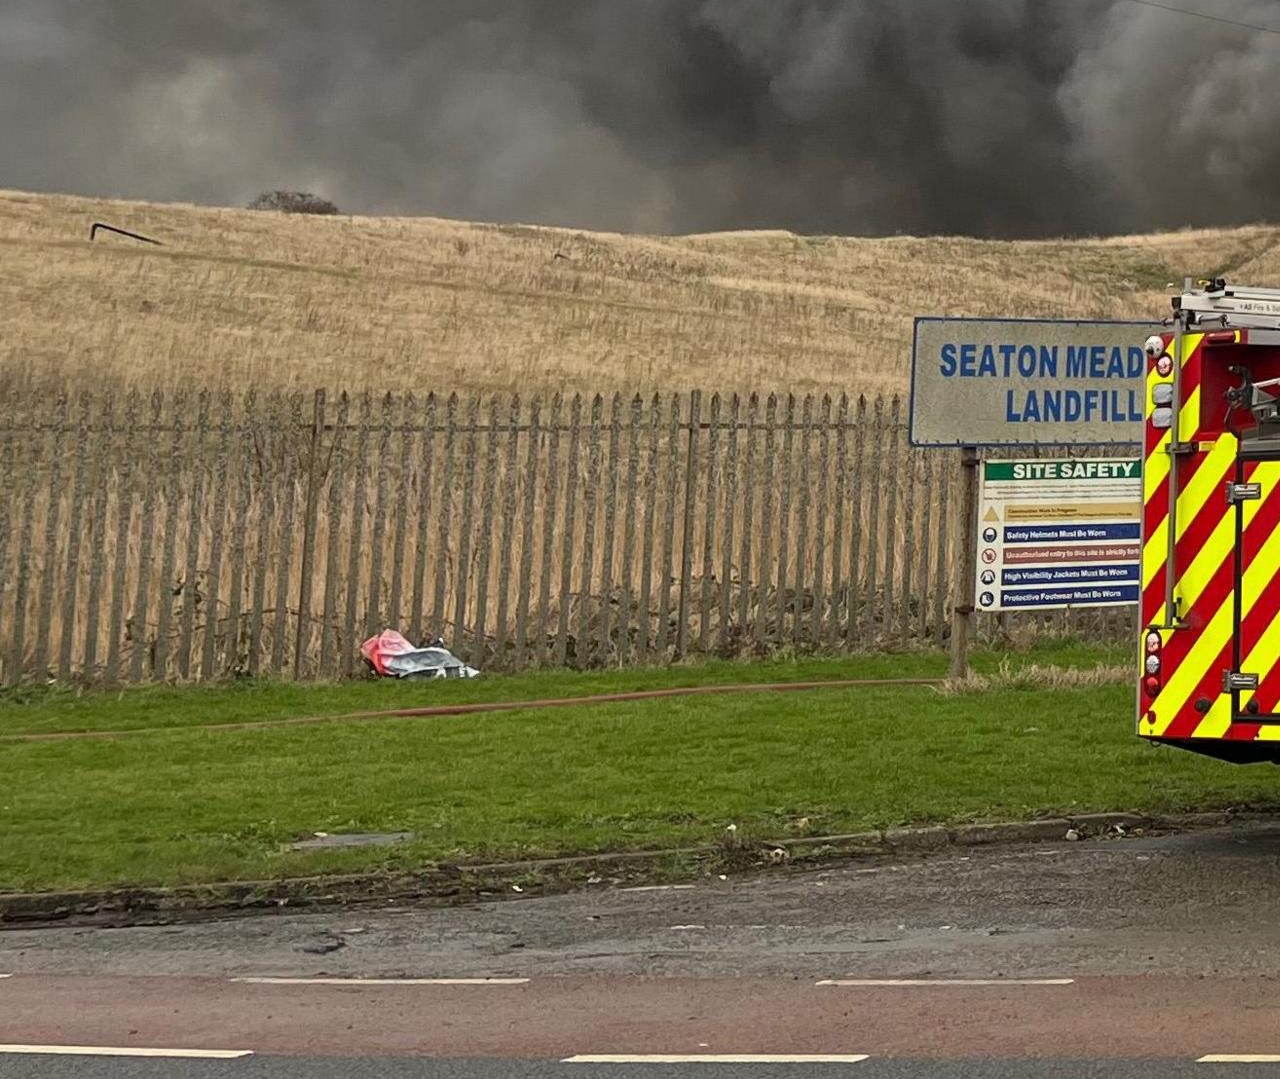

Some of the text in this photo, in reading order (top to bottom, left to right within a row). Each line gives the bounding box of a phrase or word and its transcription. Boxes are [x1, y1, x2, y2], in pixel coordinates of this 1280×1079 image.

[940, 343, 1058, 378] SEATON
[1006, 390, 1143, 422] LANDFILL
[1013, 463, 1135, 479] SITE SAFETY
[1006, 531, 1029, 540] Safety
[1030, 529, 1058, 539] Helmets
[1060, 529, 1077, 537] Must
[1078, 529, 1087, 537] Be
[1050, 550, 1065, 559] entry
[1105, 548, 1126, 557] strictly
[1004, 572, 1021, 581] High
[1022, 571, 1052, 580] Visibility
[1053, 570, 1080, 579] Jackets
[1099, 569, 1108, 577] Be
[1003, 590, 1121, 602] Protective Footwear Must Be Worn
